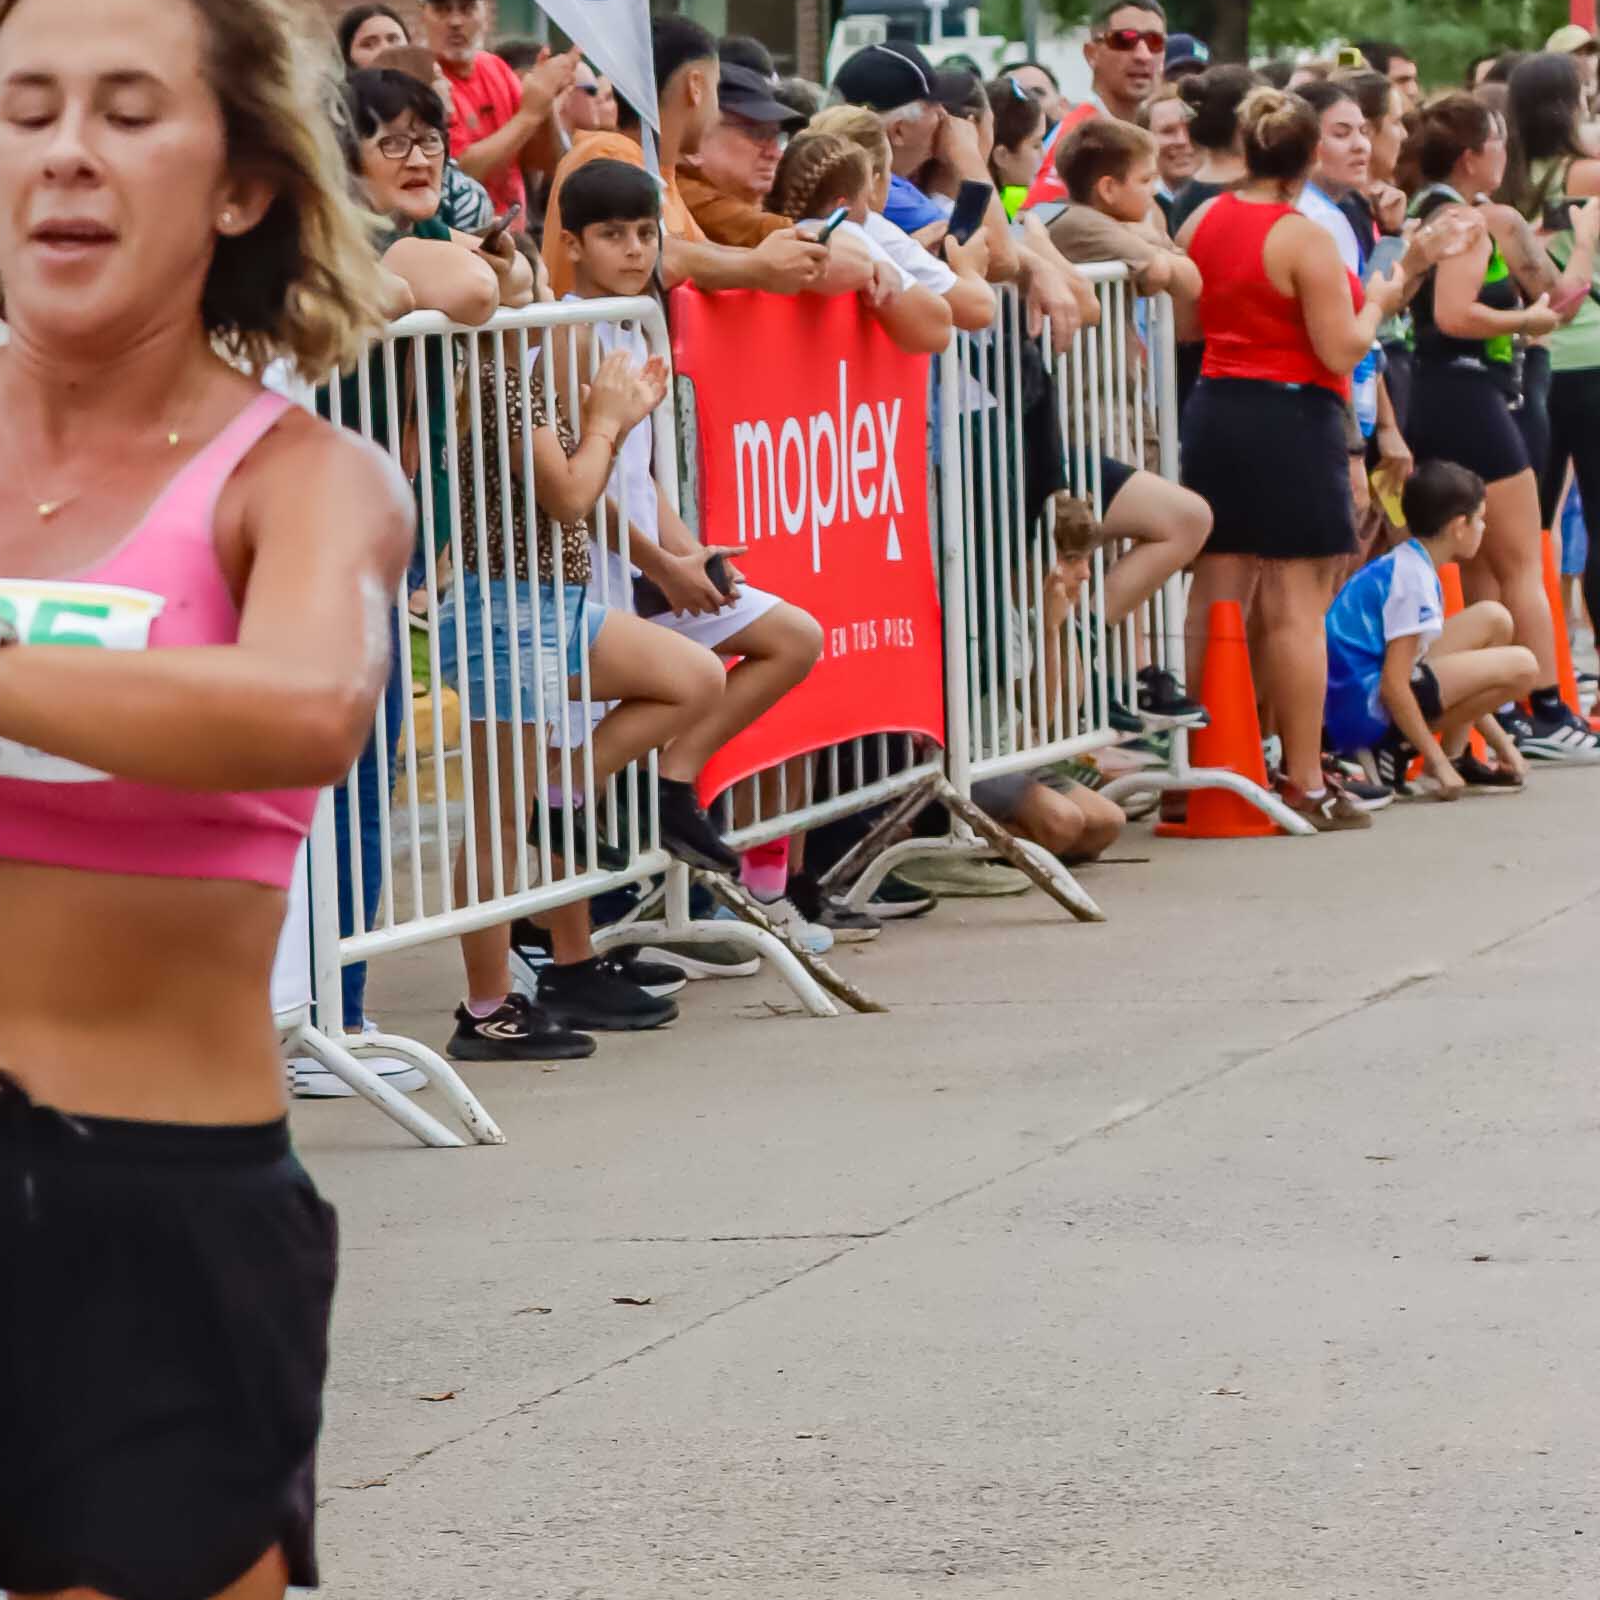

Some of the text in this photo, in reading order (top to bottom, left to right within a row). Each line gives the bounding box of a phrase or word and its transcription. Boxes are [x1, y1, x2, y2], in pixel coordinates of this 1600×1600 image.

[733, 359, 905, 573] moplex
[831, 618, 915, 657] EN TUS PIES
